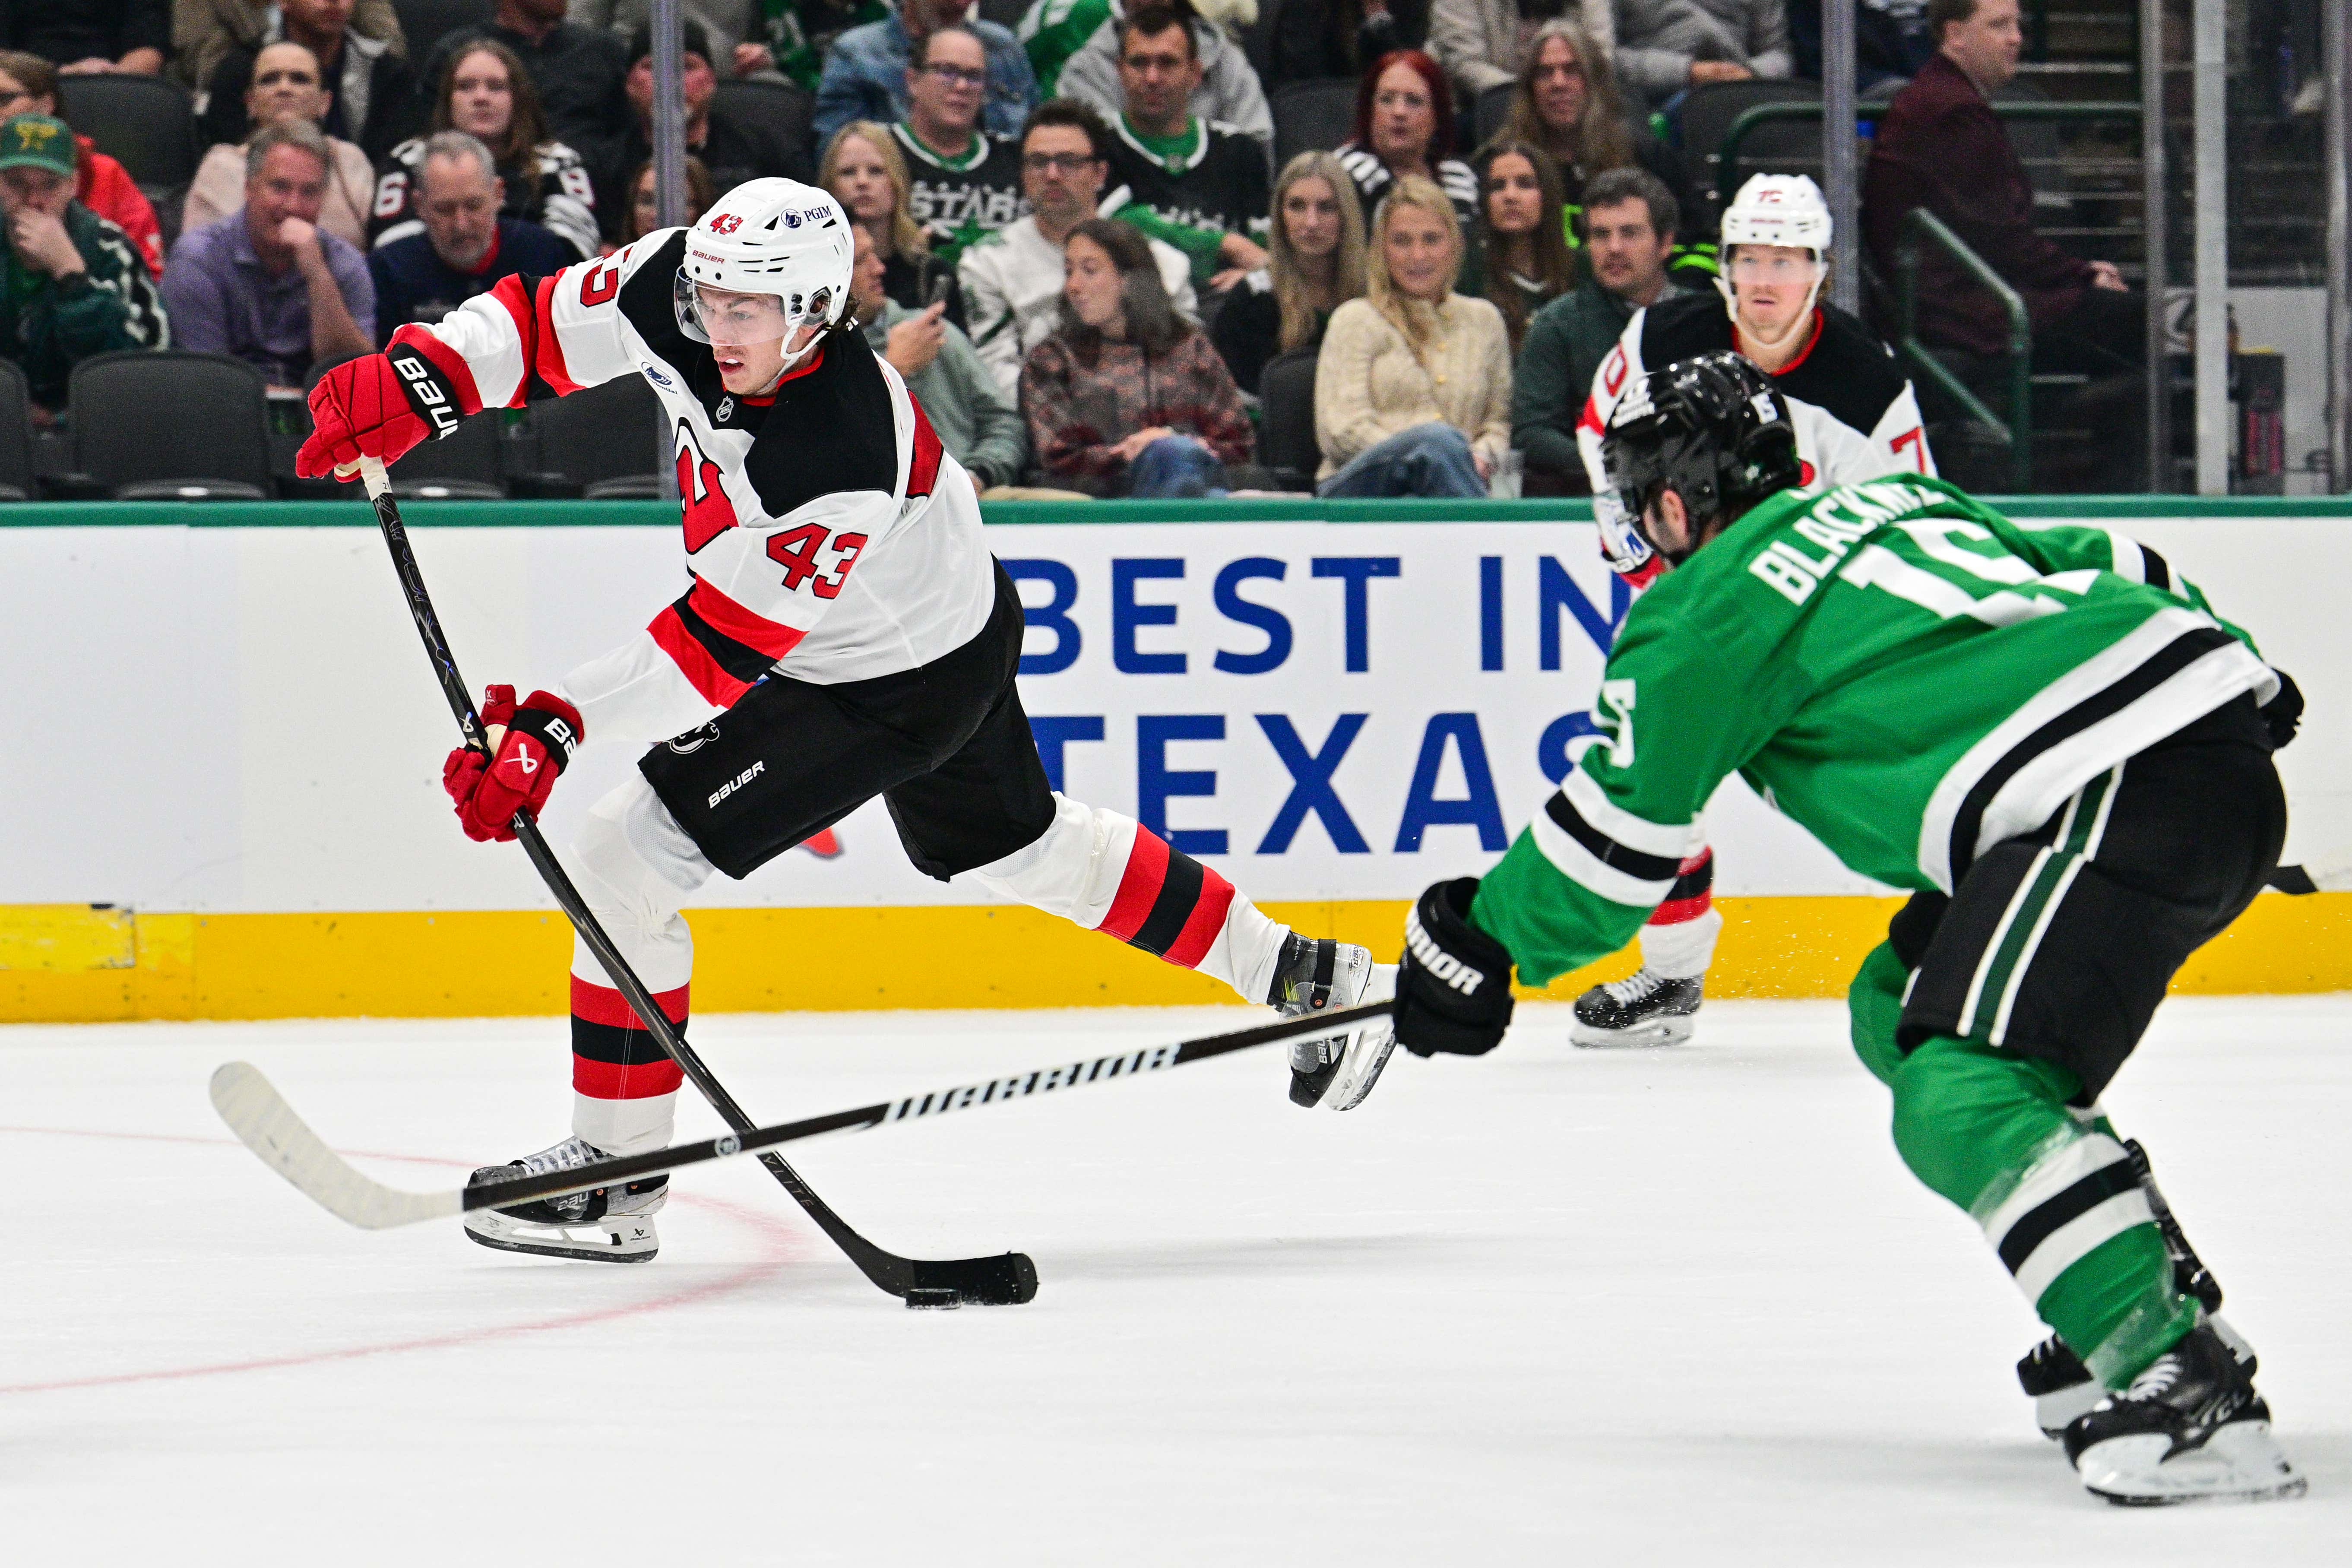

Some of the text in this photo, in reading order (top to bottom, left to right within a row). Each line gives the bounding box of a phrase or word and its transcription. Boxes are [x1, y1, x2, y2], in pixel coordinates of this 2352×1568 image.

[709, 213, 744, 235] 43
[803, 205, 832, 222] PGIM
[692, 249, 725, 264] BAUER
[1890, 426, 1927, 474] 7
[766, 522, 868, 600] 43
[1838, 518, 2101, 629] 15
[1001, 556, 1637, 675] BEST IN
[708, 760, 765, 809] BAUER
[1318, 1038, 1328, 1064] BAU
